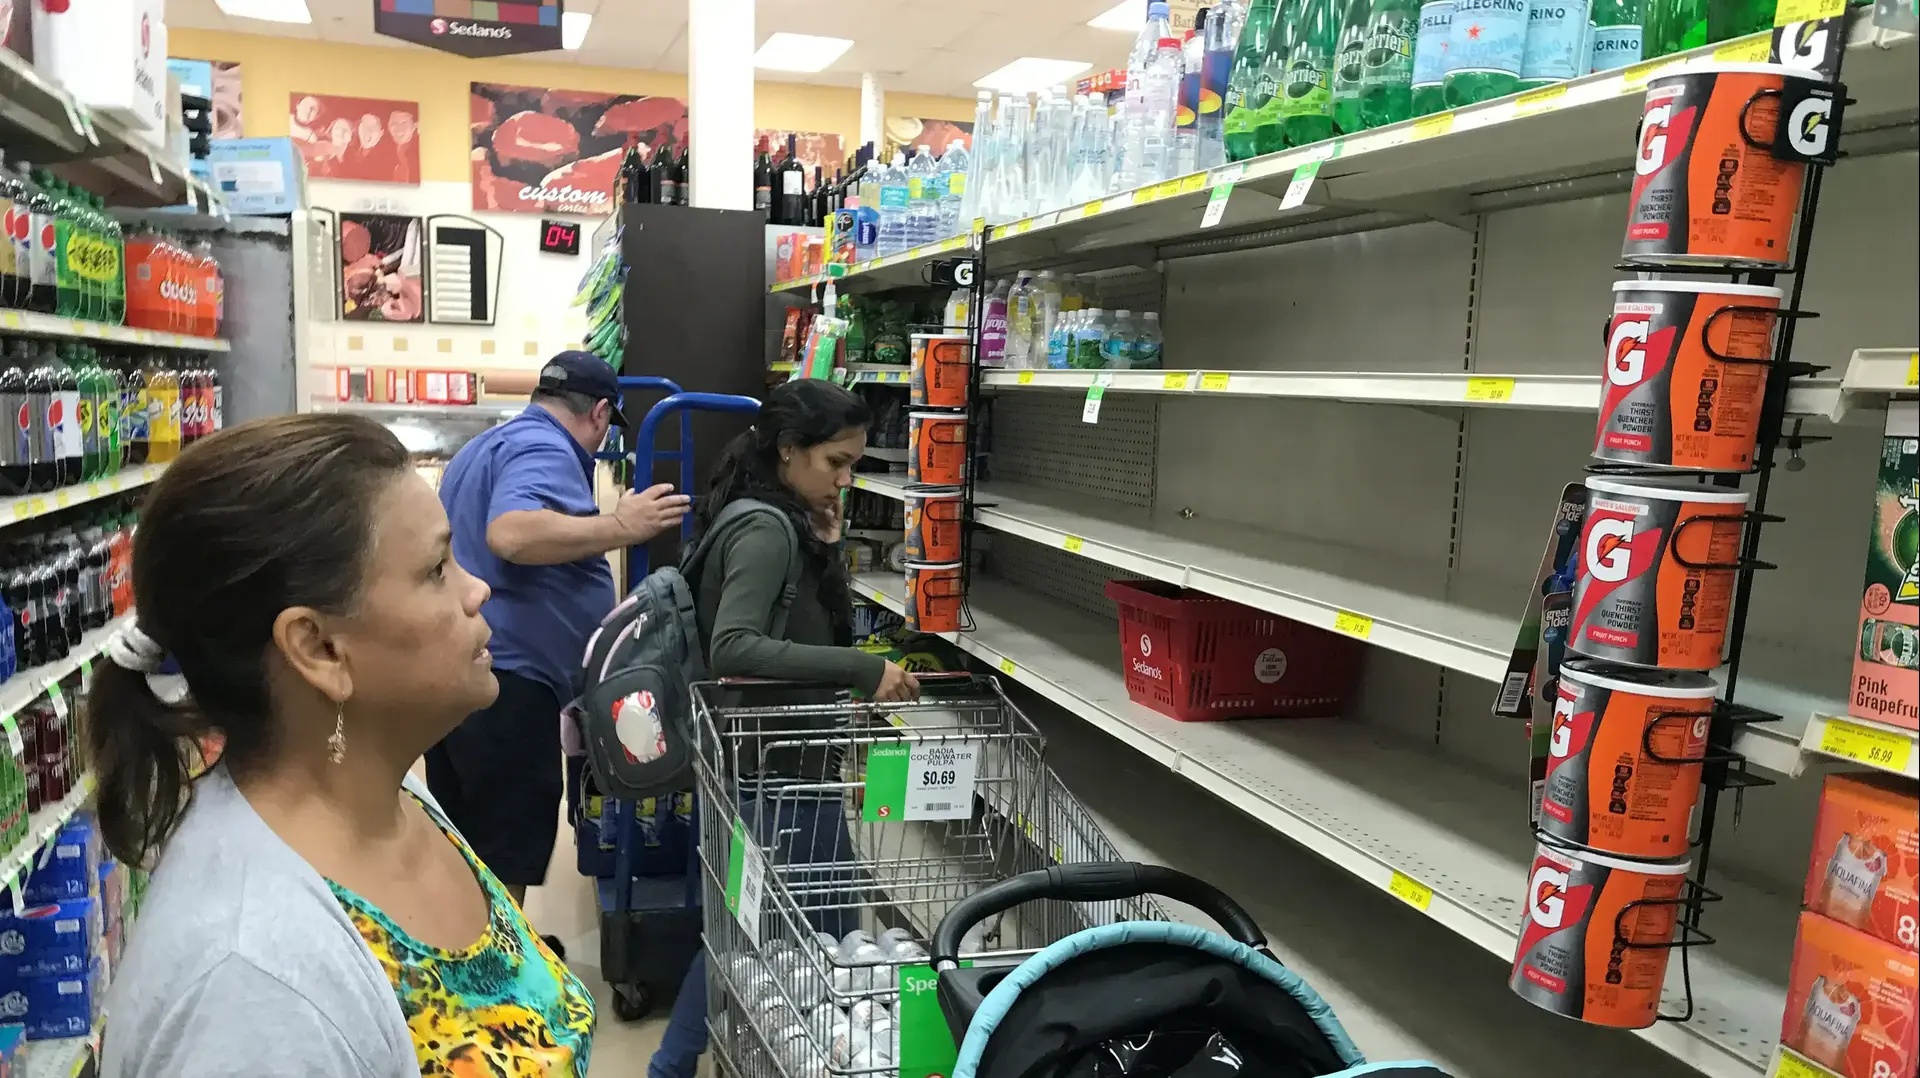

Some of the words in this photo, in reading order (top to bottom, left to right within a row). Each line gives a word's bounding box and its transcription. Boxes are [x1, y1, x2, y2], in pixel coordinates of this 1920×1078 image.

[449, 21, 512, 40] Sedano's
[1788, 98, 1832, 156] G
[1635, 104, 1672, 176] G
[519, 184, 609, 204] custom
[1650, 194, 1674, 202] THIRST
[1639, 203, 1672, 213] QUENCHER
[1642, 212, 1670, 221] POWDER
[545, 225, 576, 248] 04
[954, 263, 974, 286] G
[1607, 320, 1650, 387] G
[1617, 414, 1654, 425] QUENCHER
[1630, 407, 1655, 417] THIRST
[1622, 423, 1653, 434] POWDER
[1609, 437, 1623, 445] FRUIT
[1623, 438, 1642, 446] PUNCH
[1615, 502, 1641, 513] GALLONS
[1585, 517, 1636, 583] G
[1600, 610, 1640, 622] QUENCHER
[1615, 604, 1642, 614] THIRST
[1607, 619, 1639, 630] POWDER
[1592, 630, 1608, 640] FRUIT
[1607, 632, 1628, 643] PUNCH
[1132, 657, 1163, 680] Sedano's
[1858, 675, 1889, 697] Pink
[1856, 691, 1918, 716] Grapefru
[1550, 696, 1576, 758] G
[872, 747, 907, 757] Sedano's
[1868, 746, 1893, 763] $6.99
[922, 770, 956, 786] $0.69
[1557, 779, 1576, 791] THIRST
[1552, 793, 1574, 807] POWDER
[1831, 862, 1873, 894] AQUAFINA
[1528, 866, 1570, 929] G
[1535, 952, 1570, 970] QUENCHER
[1539, 962, 1568, 977] POWDER
[905, 976, 938, 996] Spe
